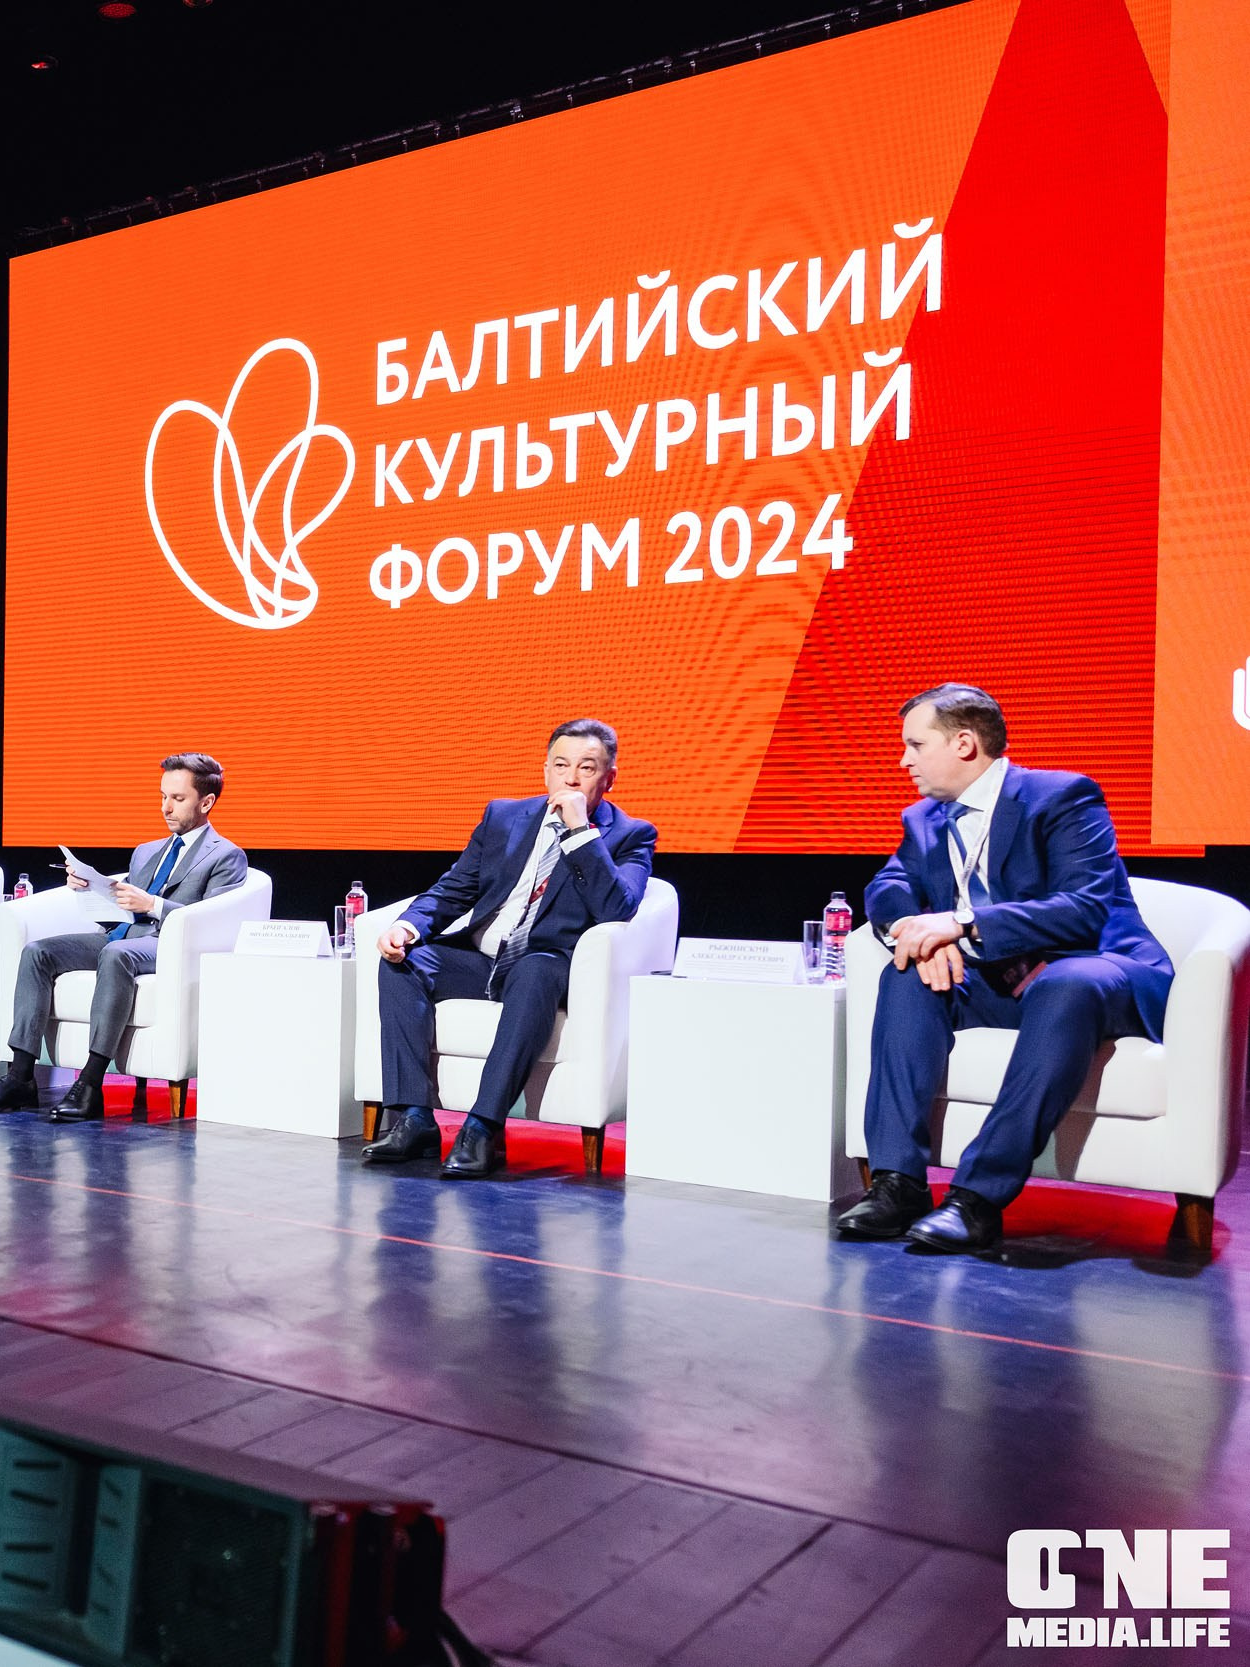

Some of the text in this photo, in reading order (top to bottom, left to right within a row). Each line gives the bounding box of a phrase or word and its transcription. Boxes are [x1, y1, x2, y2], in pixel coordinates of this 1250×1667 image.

[376, 217, 943, 406] БАЛТИЙСКИЙ
[374, 347, 912, 508] КУЛЬТУРНЫЙ
[369, 493, 855, 609] ФОРУМ 2024
